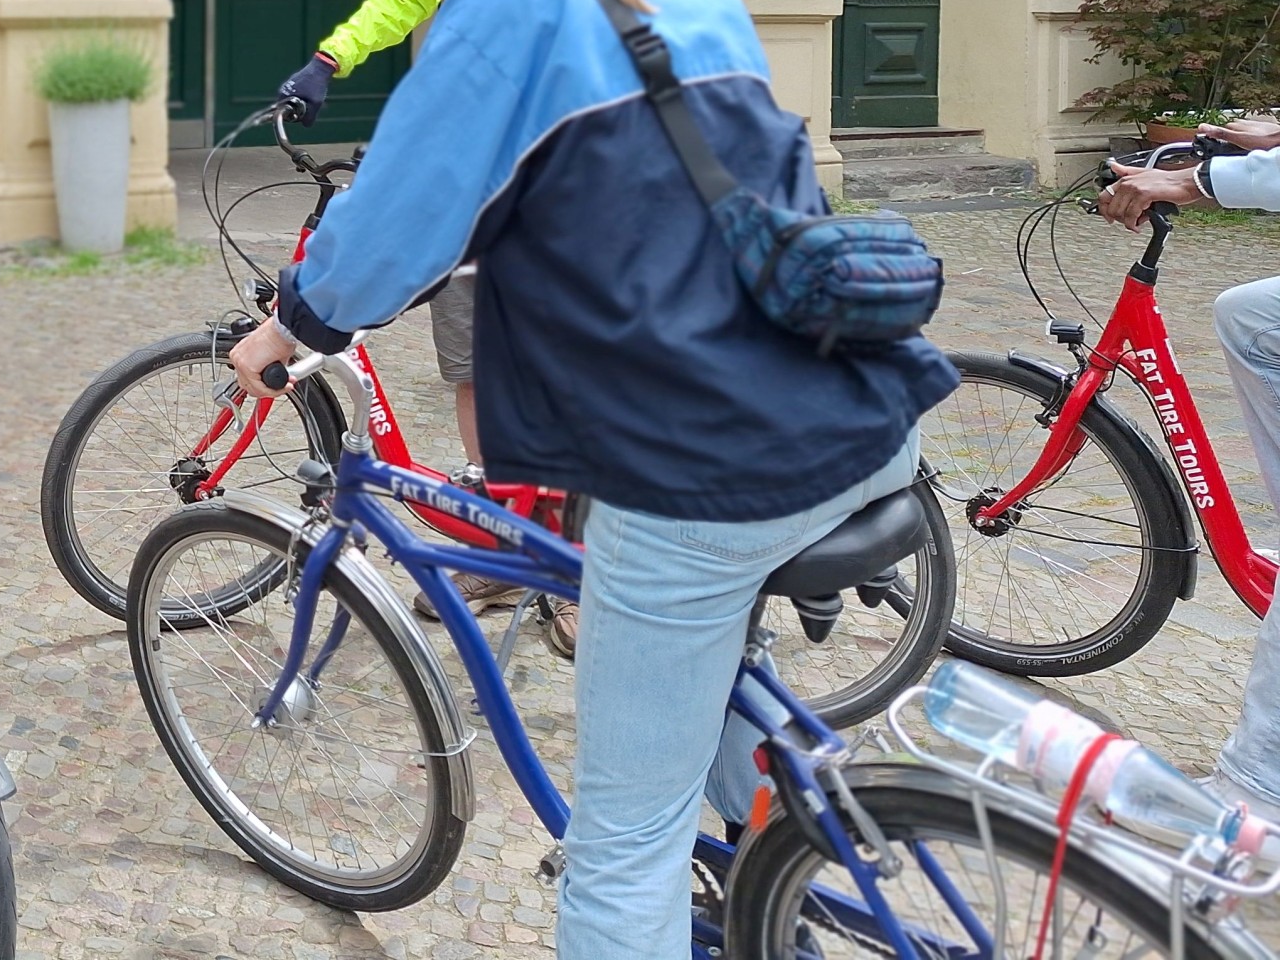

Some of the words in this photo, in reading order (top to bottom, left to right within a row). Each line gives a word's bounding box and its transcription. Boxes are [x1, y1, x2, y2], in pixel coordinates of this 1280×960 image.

[1136, 347, 1164, 384] FAT
[1154, 387, 1185, 435] TIRE
[1174, 438, 1215, 510] TOURS
[389, 474, 420, 499] FAT
[424, 485, 462, 519] TIRE
[466, 501, 525, 546] TOURS
[1061, 633, 1124, 665] CONTINENTAL
